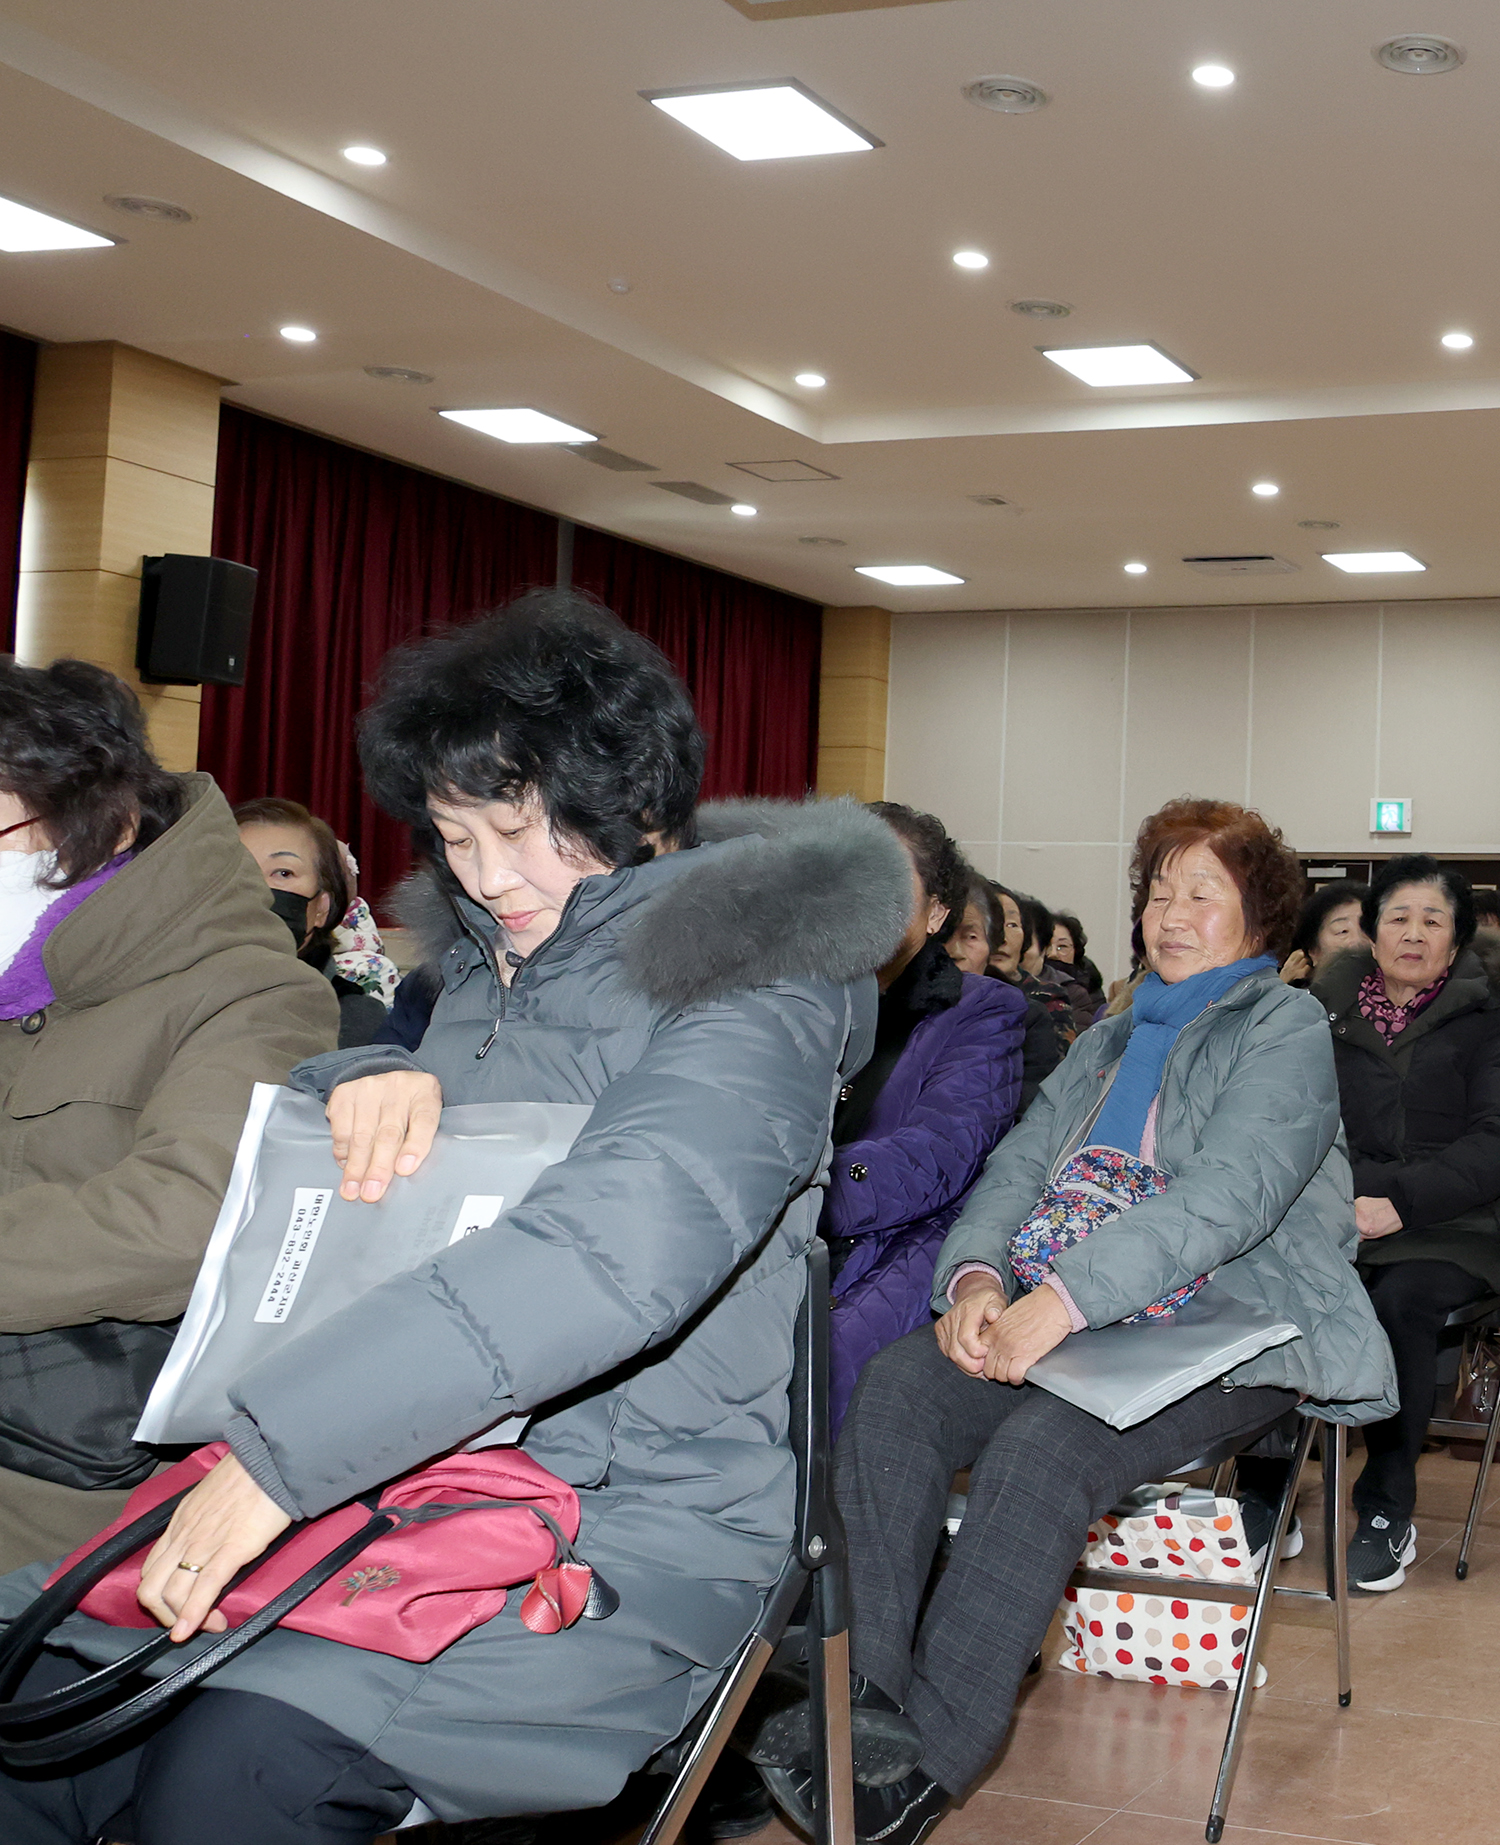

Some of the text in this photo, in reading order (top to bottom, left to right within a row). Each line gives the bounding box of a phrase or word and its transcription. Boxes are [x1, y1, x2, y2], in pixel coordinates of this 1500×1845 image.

[267, 1208, 306, 1302] 043-832-2444
[274, 1194, 324, 1318] 대한노인회 괴산군지회
